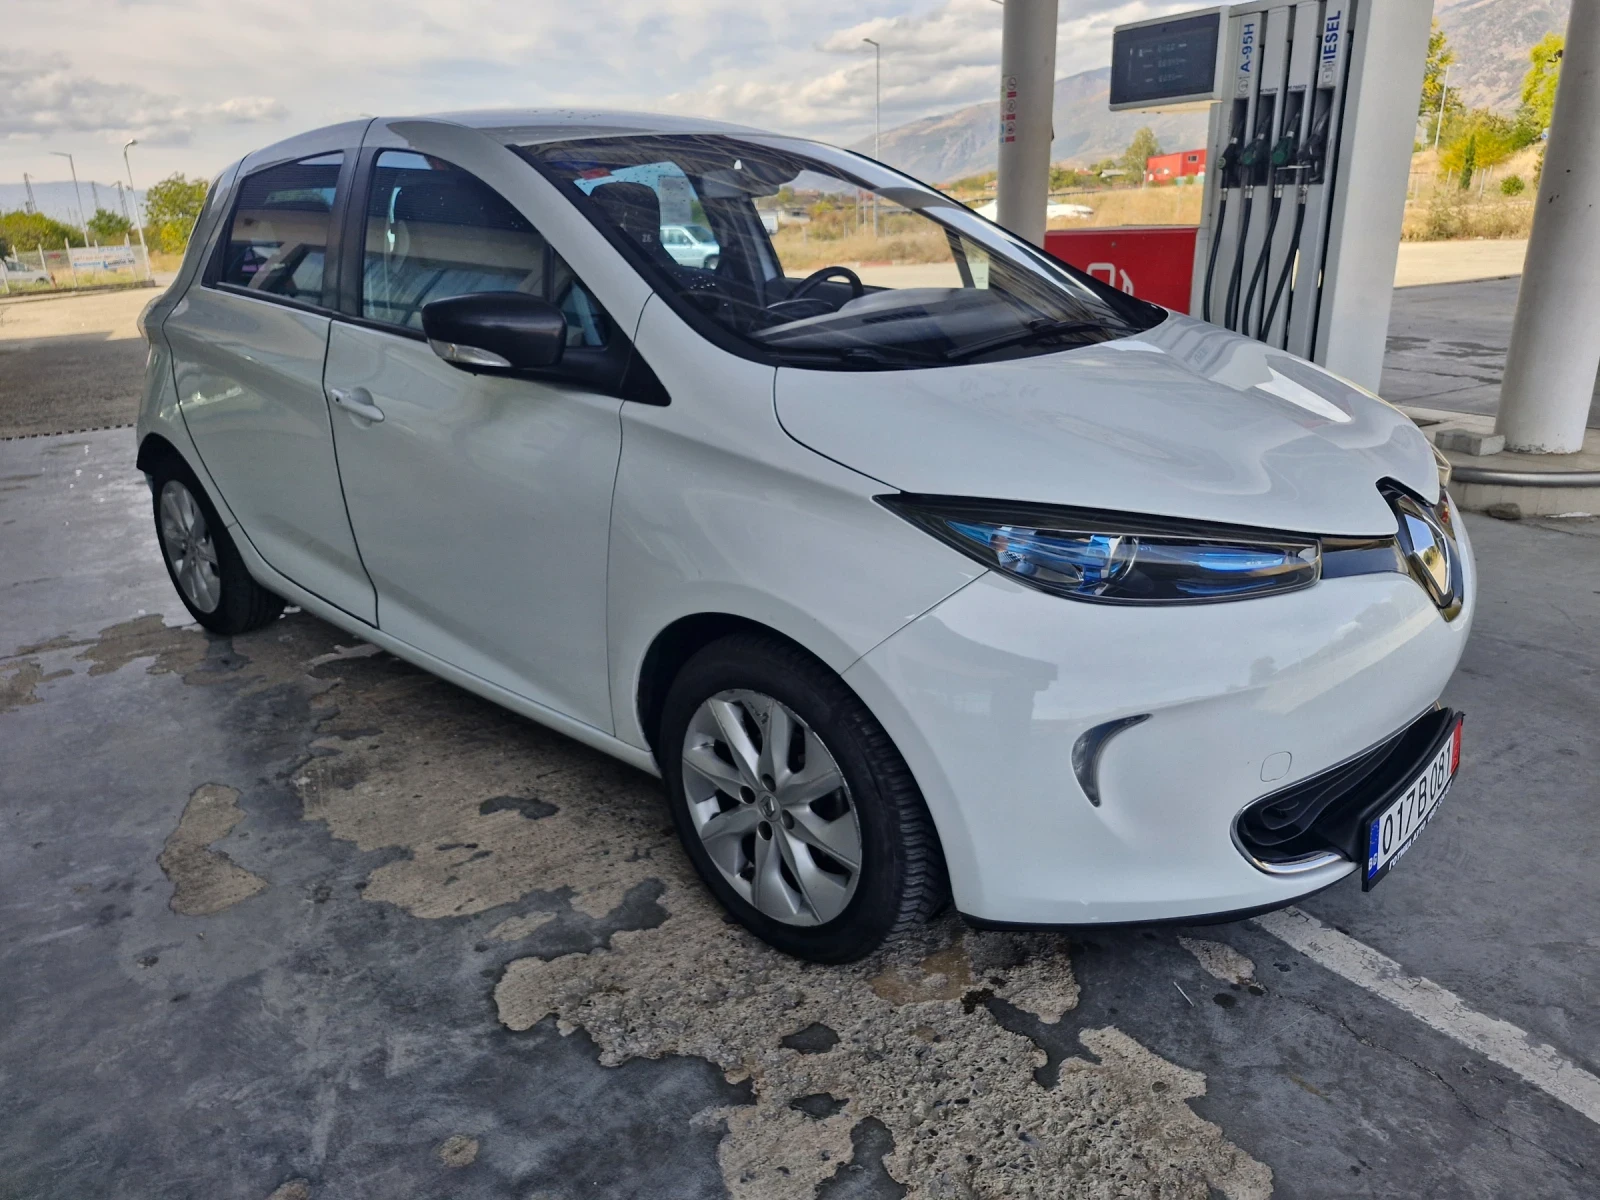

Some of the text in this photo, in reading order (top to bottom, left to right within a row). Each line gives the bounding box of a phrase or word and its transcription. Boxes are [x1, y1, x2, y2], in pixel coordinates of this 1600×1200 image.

[1240, 23, 1255, 73] A-95H
[1322, 10, 1342, 64] IESEL
[1368, 852, 1378, 871] BG
